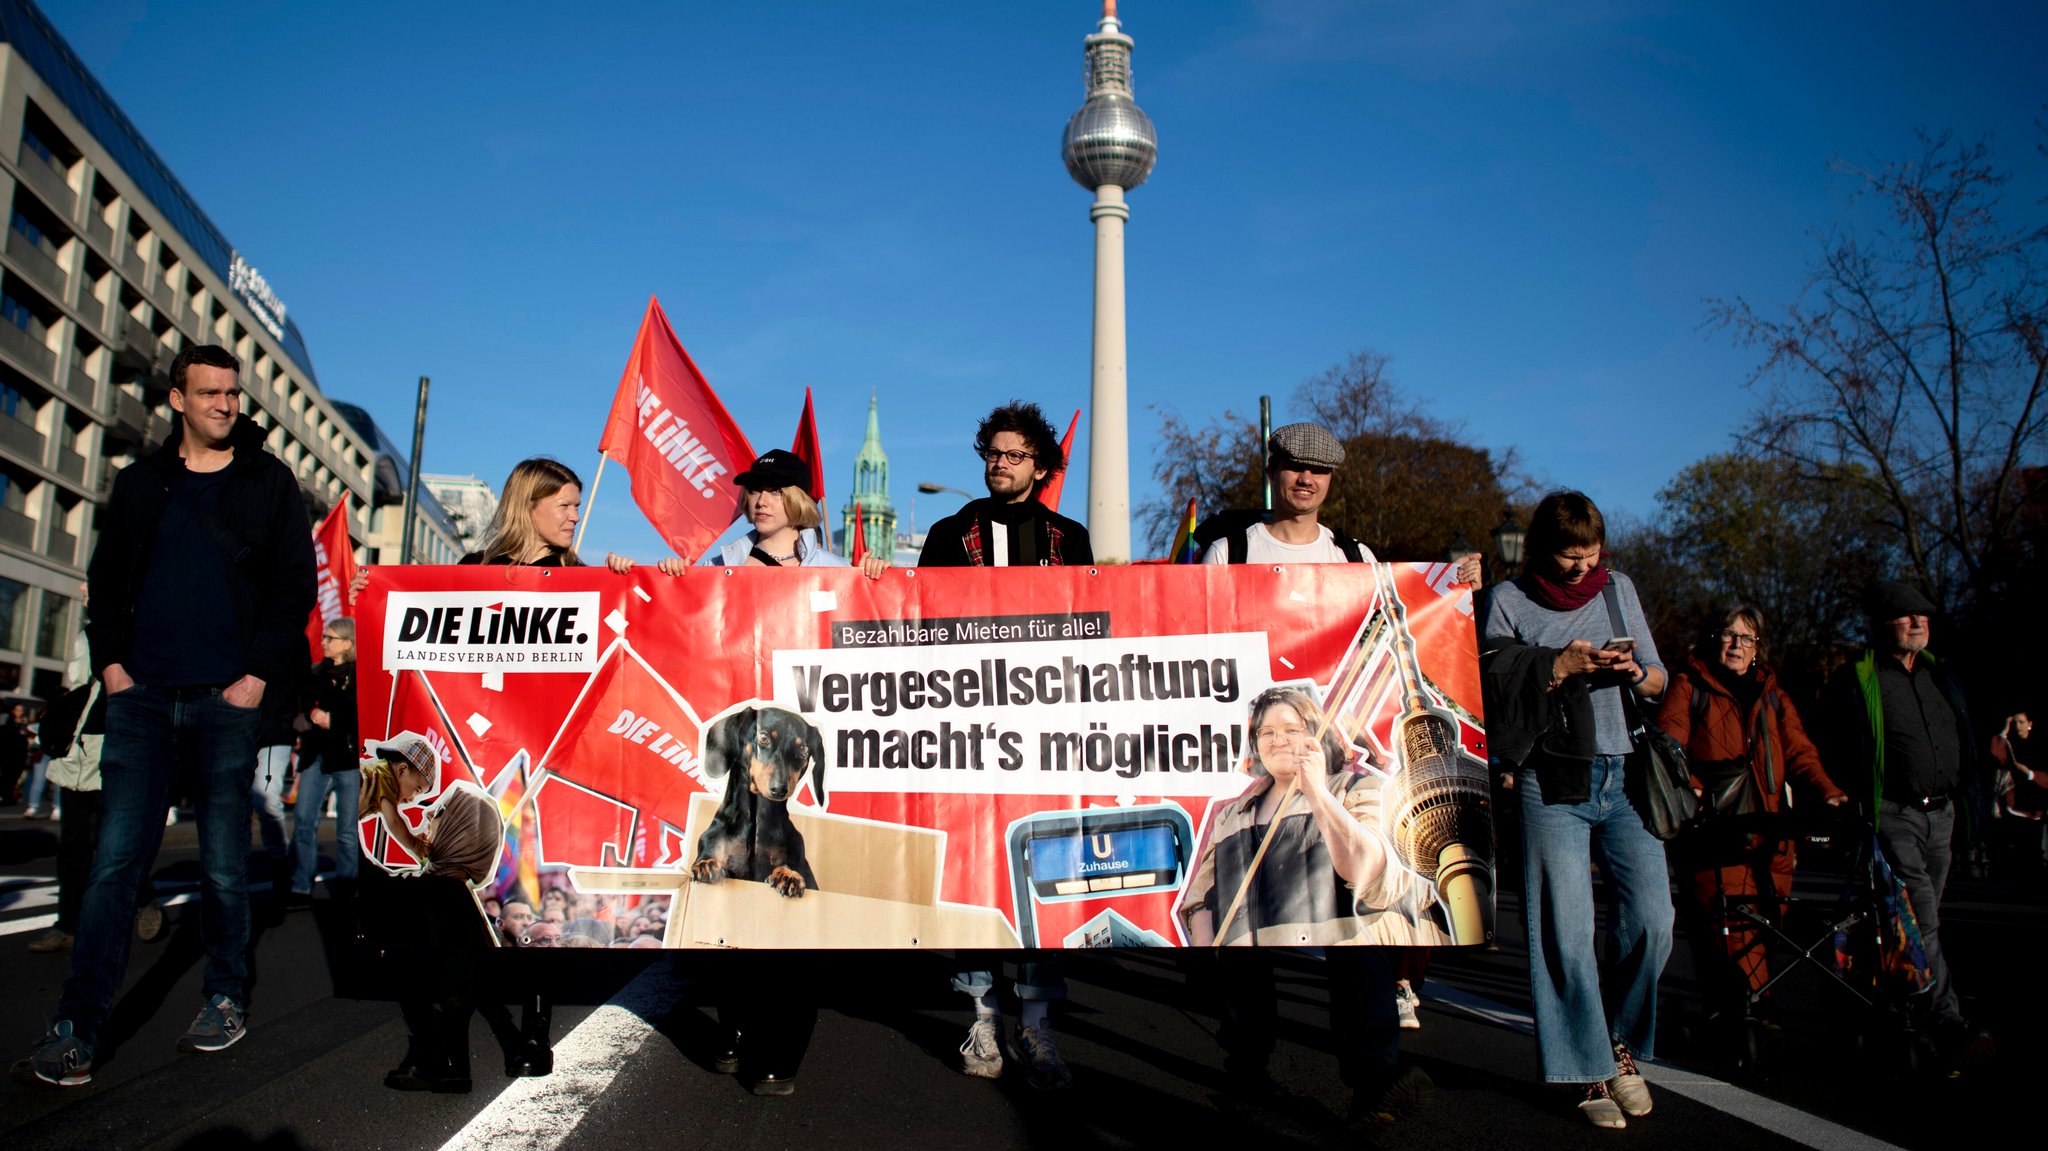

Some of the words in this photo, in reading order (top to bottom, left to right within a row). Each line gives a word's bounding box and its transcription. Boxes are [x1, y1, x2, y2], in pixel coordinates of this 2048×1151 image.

[397, 607, 464, 645] DIE
[842, 623, 949, 645] Bezahlbare
[955, 621, 1022, 641] Mieten
[1028, 619, 1056, 638] für
[1062, 618, 1102, 637] alle!
[397, 650, 526, 662] LANDESVERBAND
[532, 652, 584, 662] BERLIN
[792, 653, 1240, 717] Vergesellschaftung
[607, 709, 661, 745] DIE
[1040, 722, 1242, 778] möglich!
[1092, 834, 1112, 858] U
[1079, 860, 1129, 873] Zuhause
